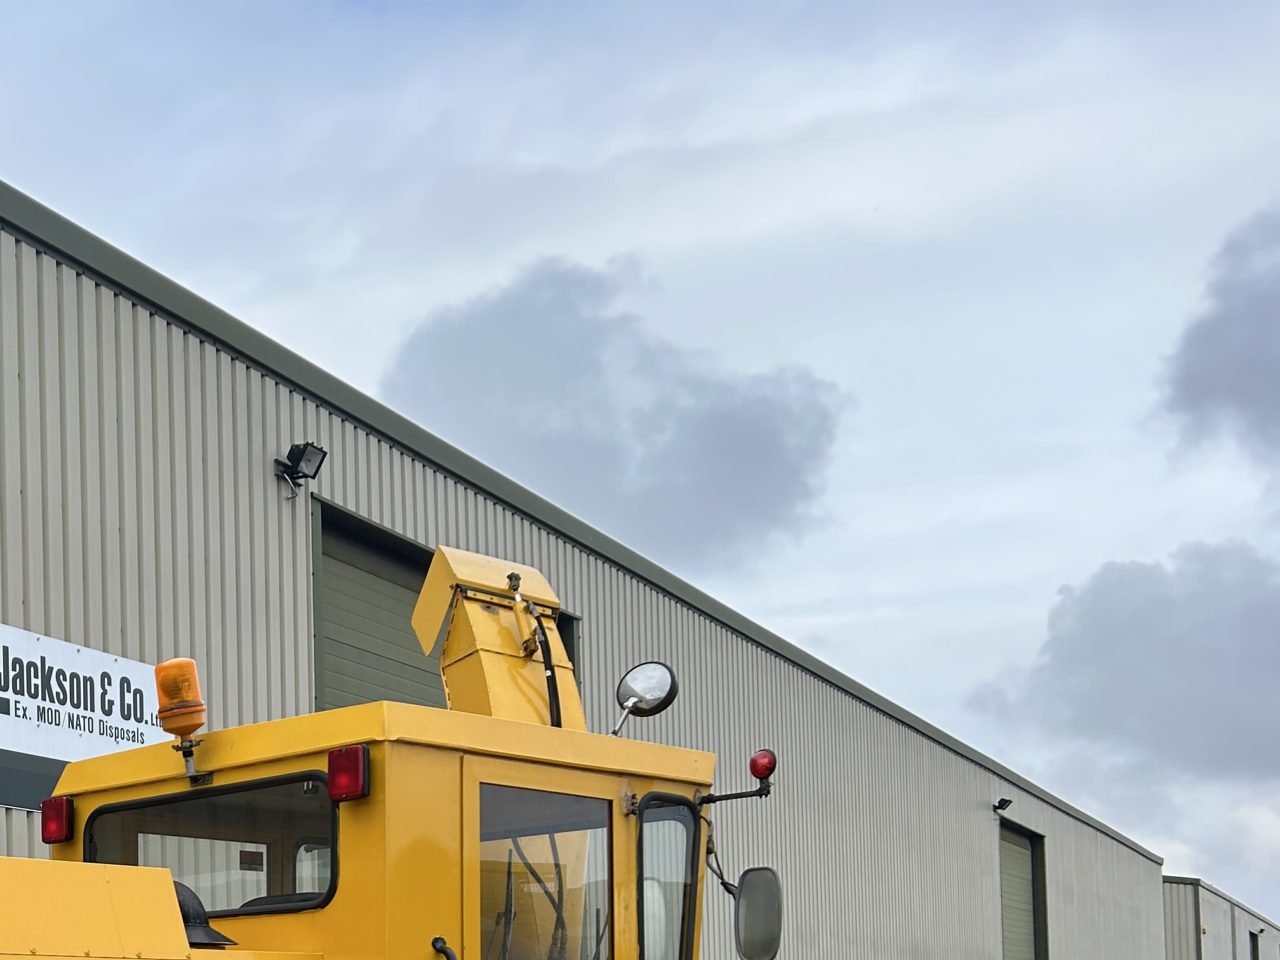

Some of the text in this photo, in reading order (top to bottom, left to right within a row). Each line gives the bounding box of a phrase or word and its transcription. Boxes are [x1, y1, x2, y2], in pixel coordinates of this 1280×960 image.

[14, 700, 32, 721] Ex.
[98, 719, 146, 745] Disposals
[100, 671, 115, 717] &
[119, 676, 149, 725] Co.
